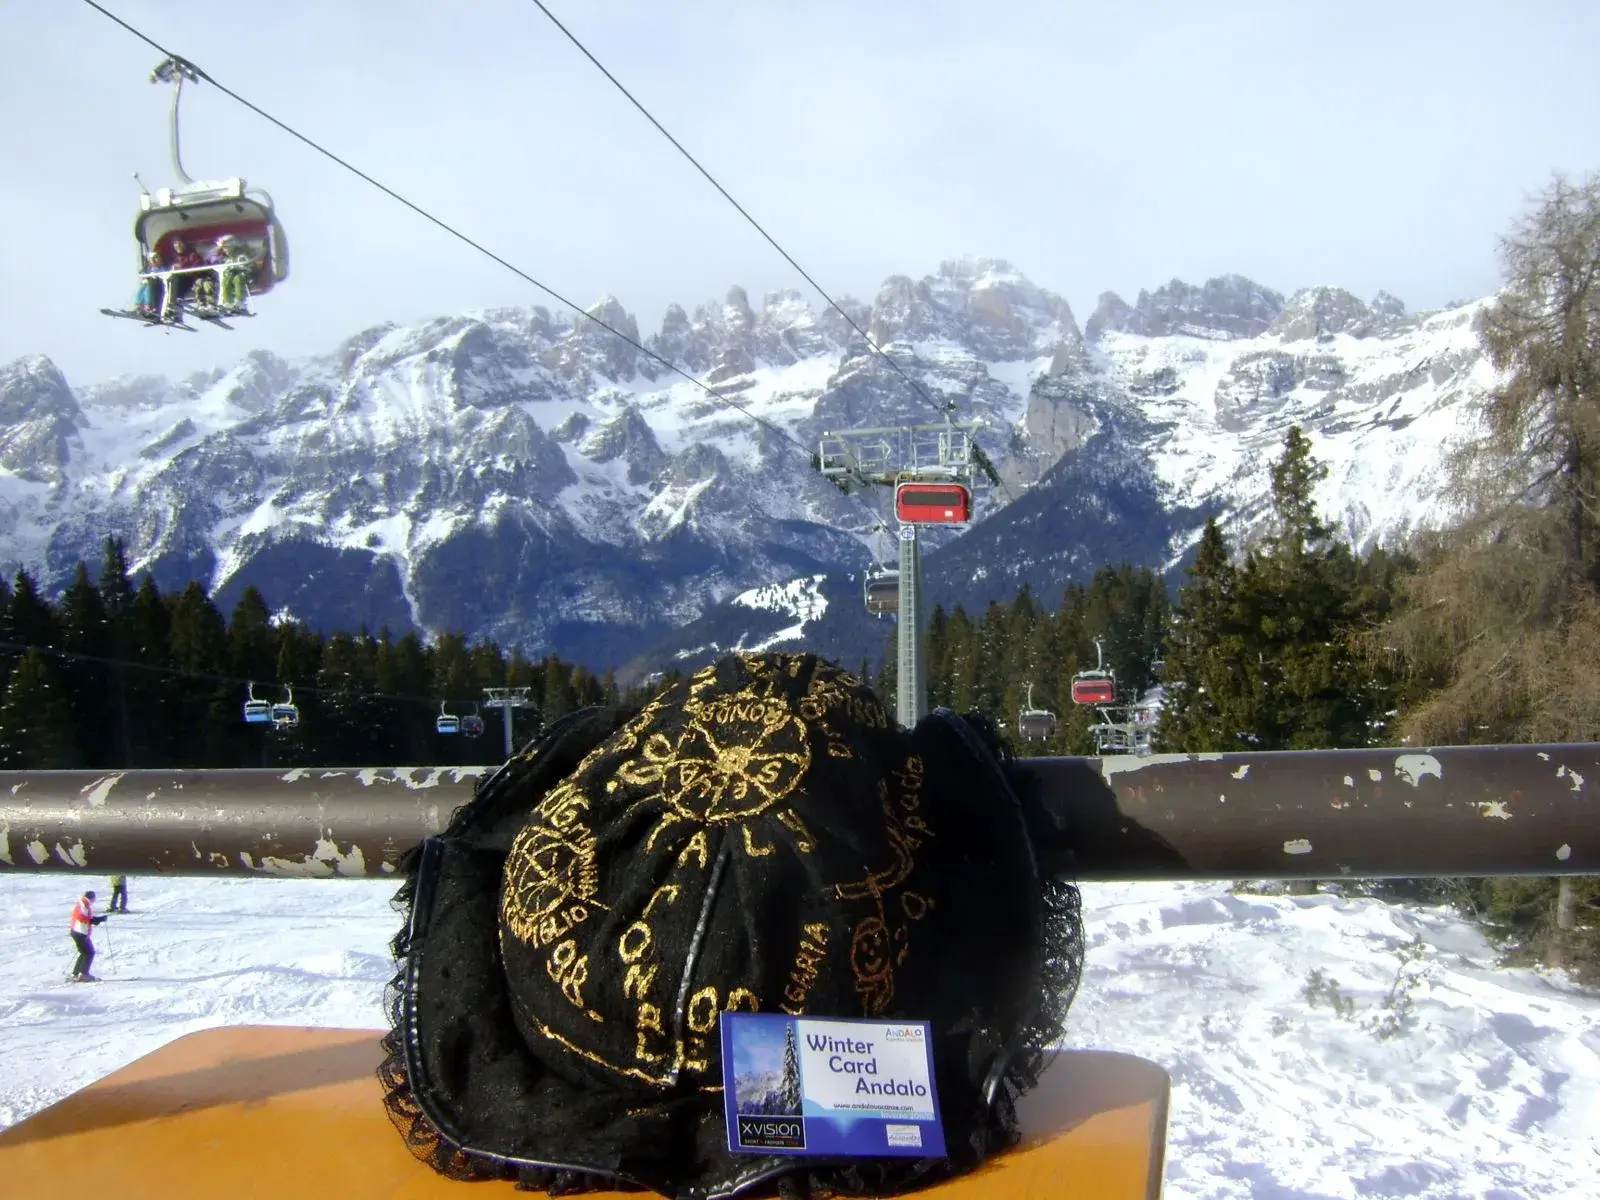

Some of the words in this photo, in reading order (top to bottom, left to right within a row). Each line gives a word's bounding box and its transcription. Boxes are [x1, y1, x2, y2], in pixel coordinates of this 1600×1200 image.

[886, 1028, 922, 1038] ANDALO
[806, 1034, 874, 1055] Winter
[829, 1056, 877, 1075] Card
[855, 1077, 927, 1097] Andalo
